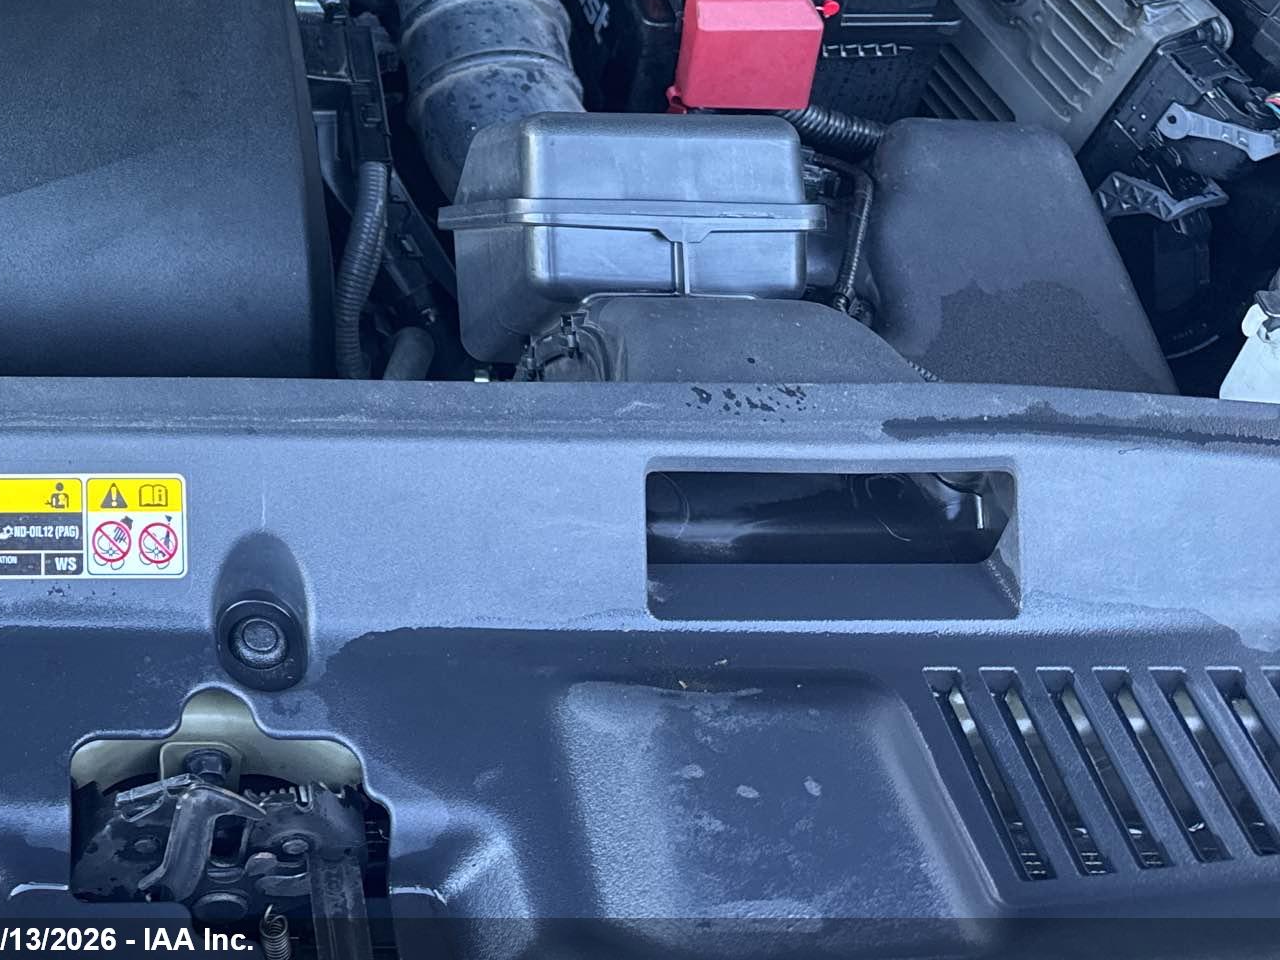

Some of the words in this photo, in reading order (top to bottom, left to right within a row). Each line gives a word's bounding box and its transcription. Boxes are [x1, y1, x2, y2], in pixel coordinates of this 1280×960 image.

[13, 525, 54, 539] ND-OIL12
[55, 525, 80, 539] (PAG)
[55, 556, 77, 571] WS
